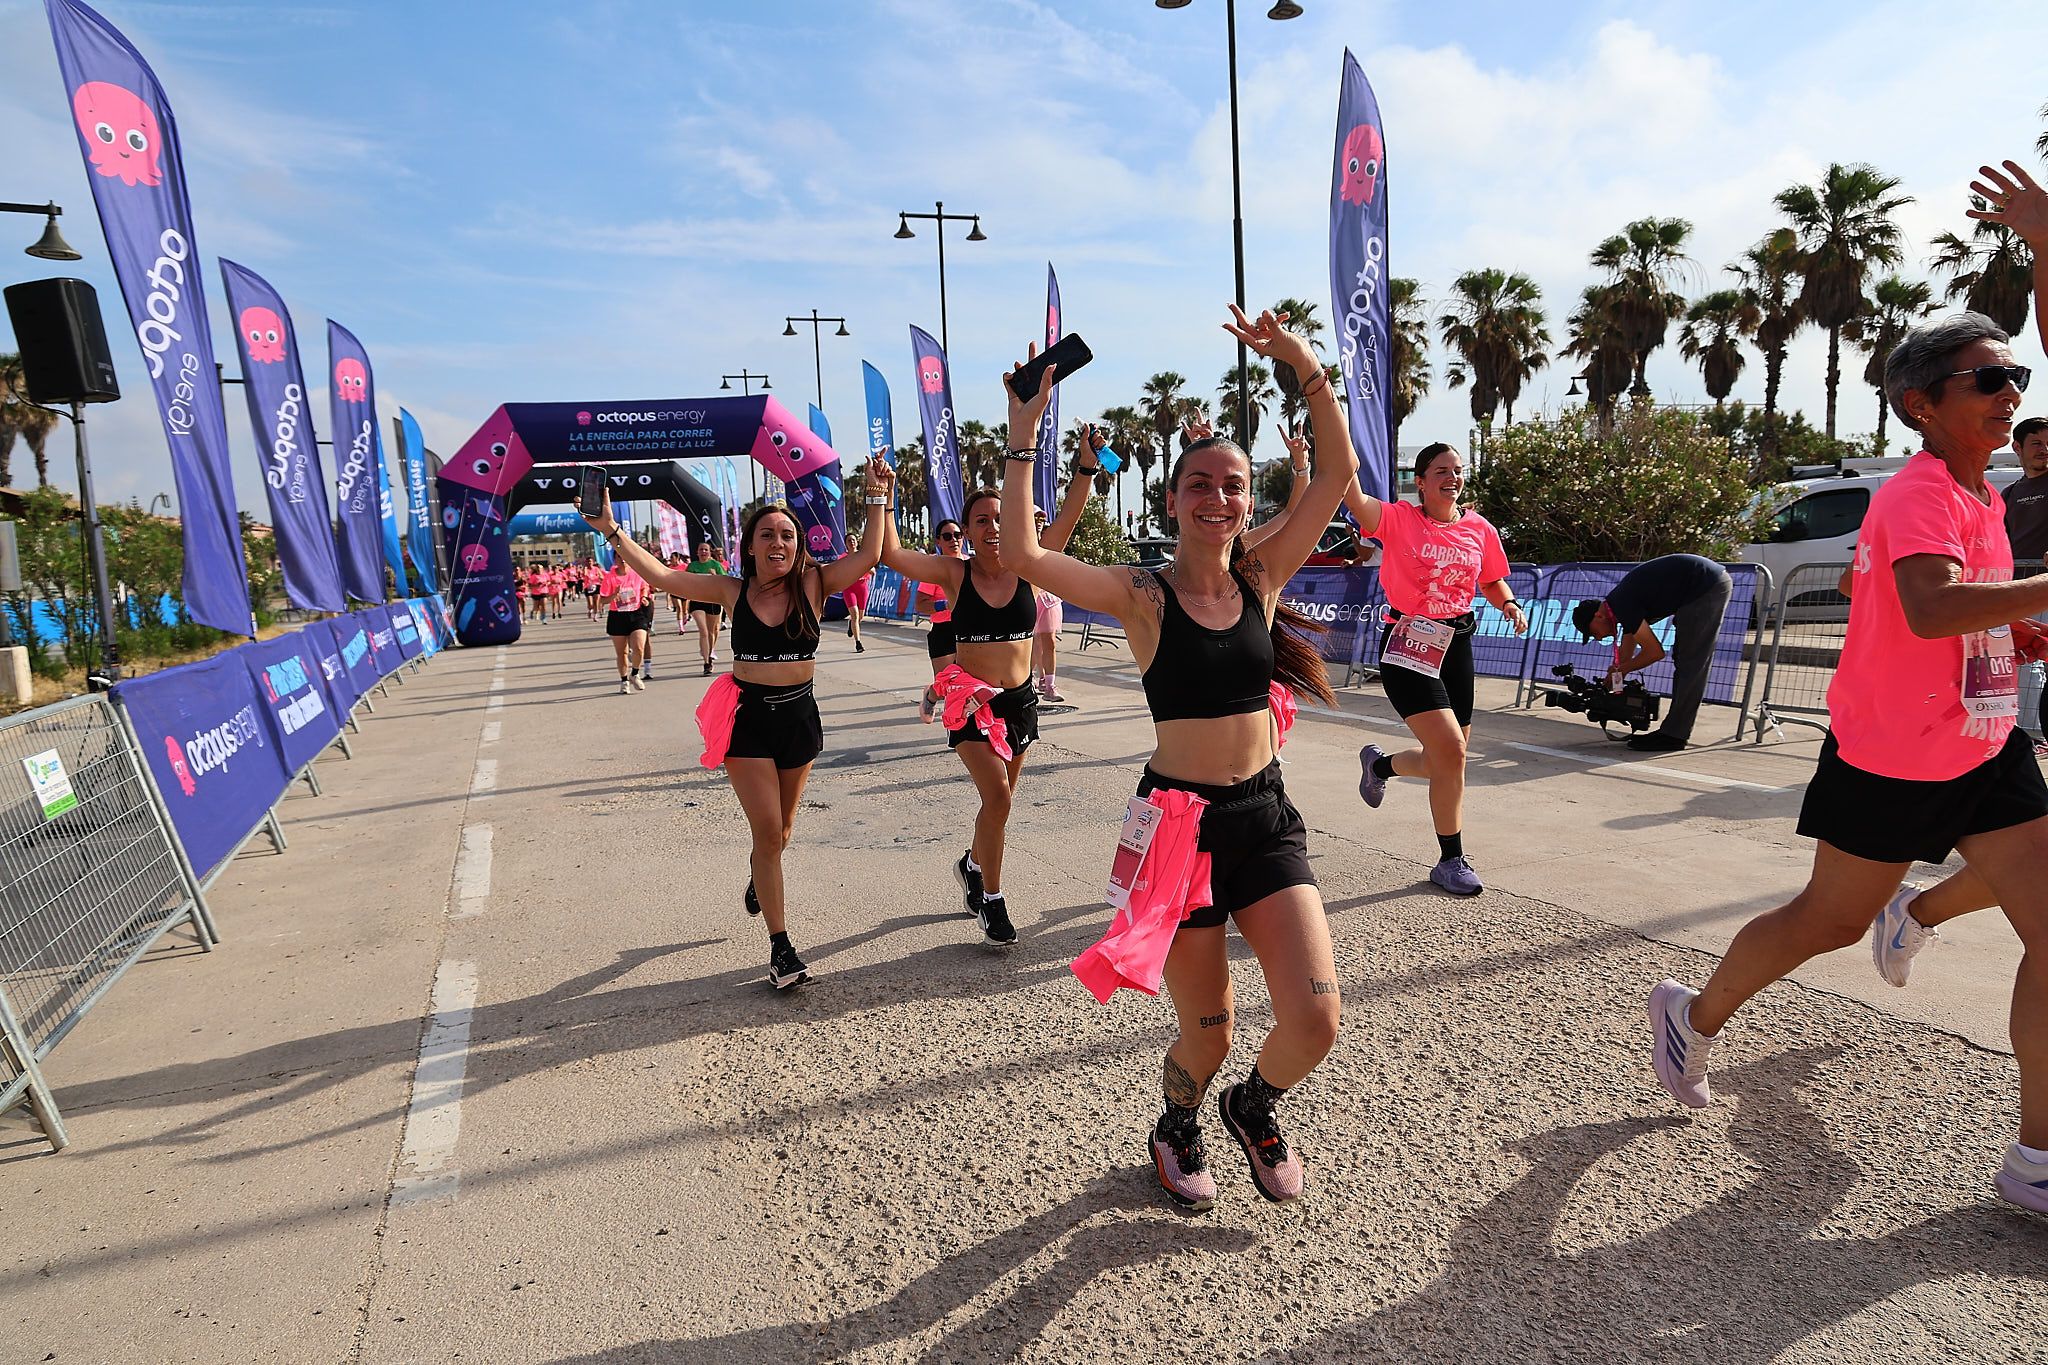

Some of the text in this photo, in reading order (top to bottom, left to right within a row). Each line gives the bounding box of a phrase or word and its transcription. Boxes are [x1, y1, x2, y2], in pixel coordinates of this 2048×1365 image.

[597, 409, 706, 425] octopus energy
[569, 429, 713, 441] LA ENERGÍA PARA CORRER
[596, 442, 659, 451] VELOCIDAD
[662, 441, 675, 449] DE
[694, 440, 715, 448] LUZ
[534, 475, 652, 490] VOVO
[970, 634, 991, 642] NIKE
[1009, 632, 1026, 640] NIKE
[1405, 638, 1429, 653] 016
[778, 653, 800, 661] NIKE
[1990, 656, 2013, 676] 016
